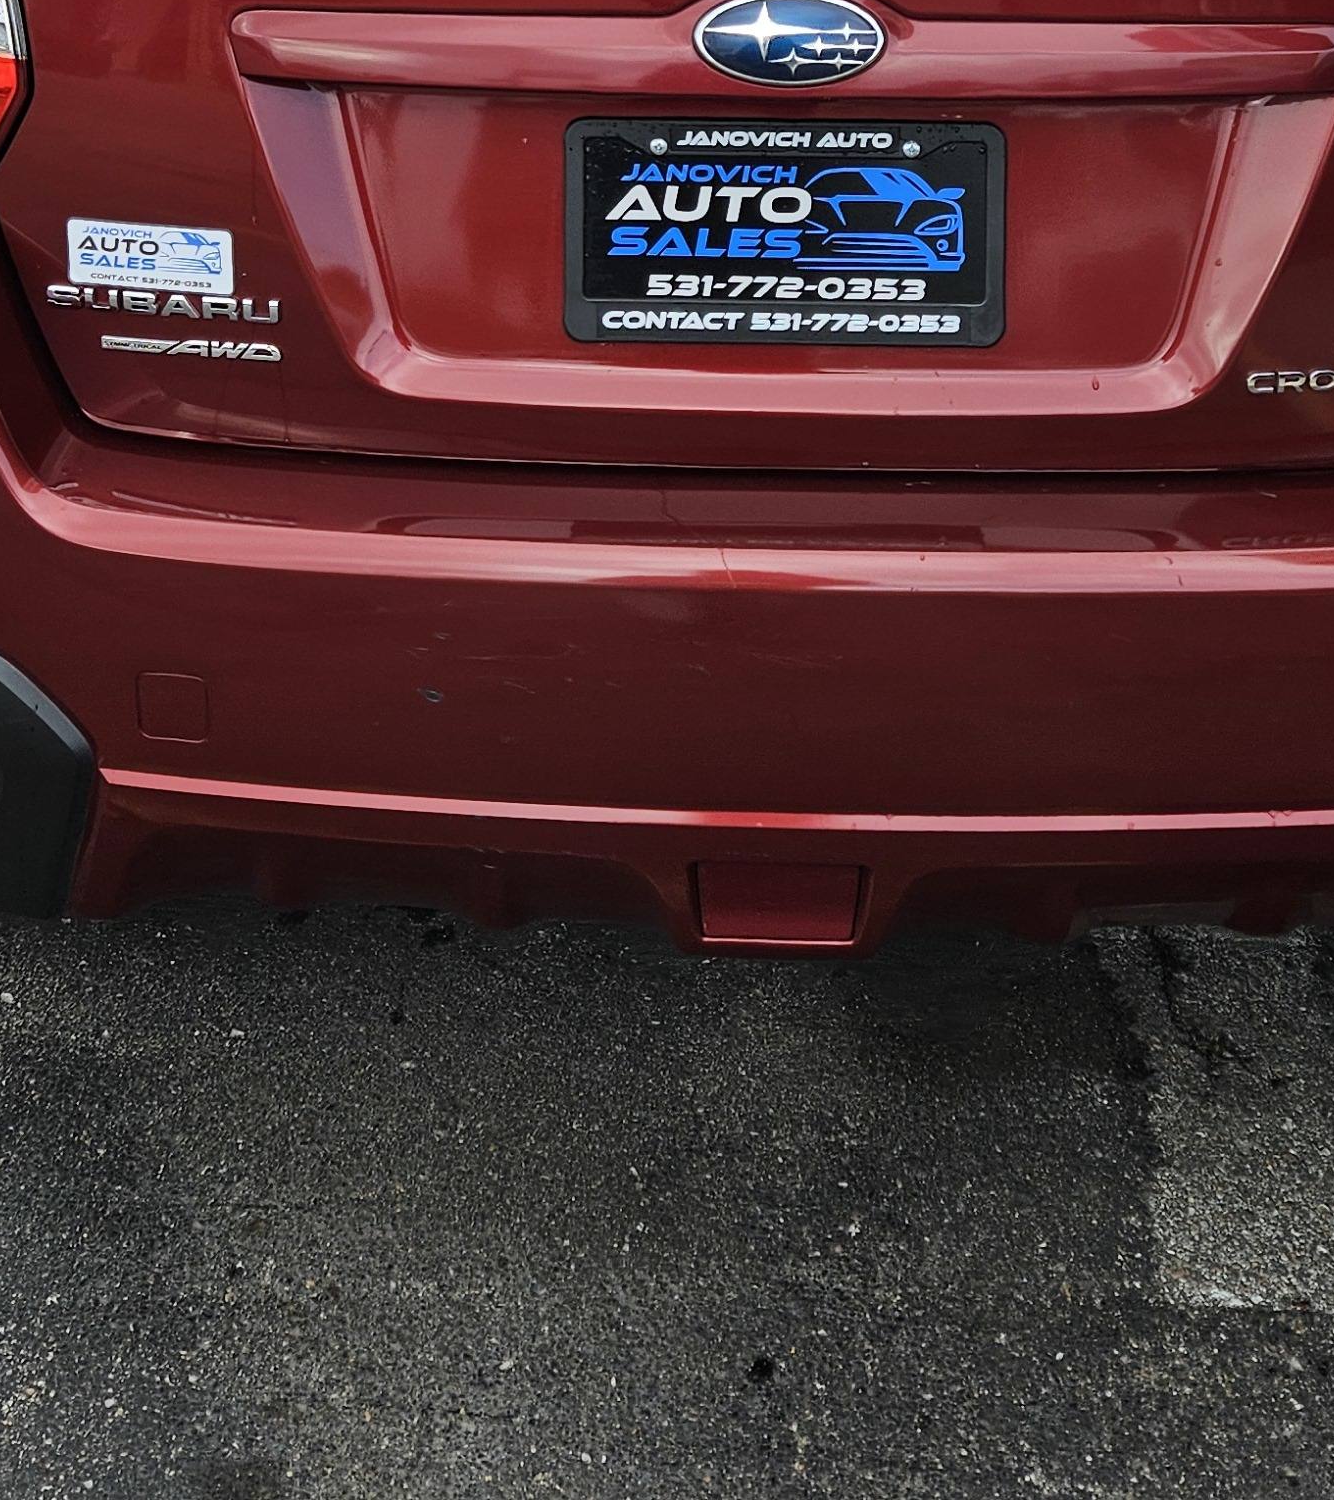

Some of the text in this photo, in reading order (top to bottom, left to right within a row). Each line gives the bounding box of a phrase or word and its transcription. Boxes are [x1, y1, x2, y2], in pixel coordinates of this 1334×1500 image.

[676, 130, 894, 150] JANOVICH AUTO
[620, 163, 798, 184] JANOVICH
[605, 185, 813, 224] AUTO
[82, 226, 153, 240] JANOVICH
[607, 226, 803, 259] SALES
[77, 235, 160, 256] AUTO
[79, 253, 156, 271] SALES
[90, 272, 139, 284] CONTACT
[646, 273, 927, 302] 531-772-0353
[46, 284, 281, 325] SUBARU
[601, 310, 961, 335] CONTACT 531-772-0353
[166, 339, 282, 363] AWD
